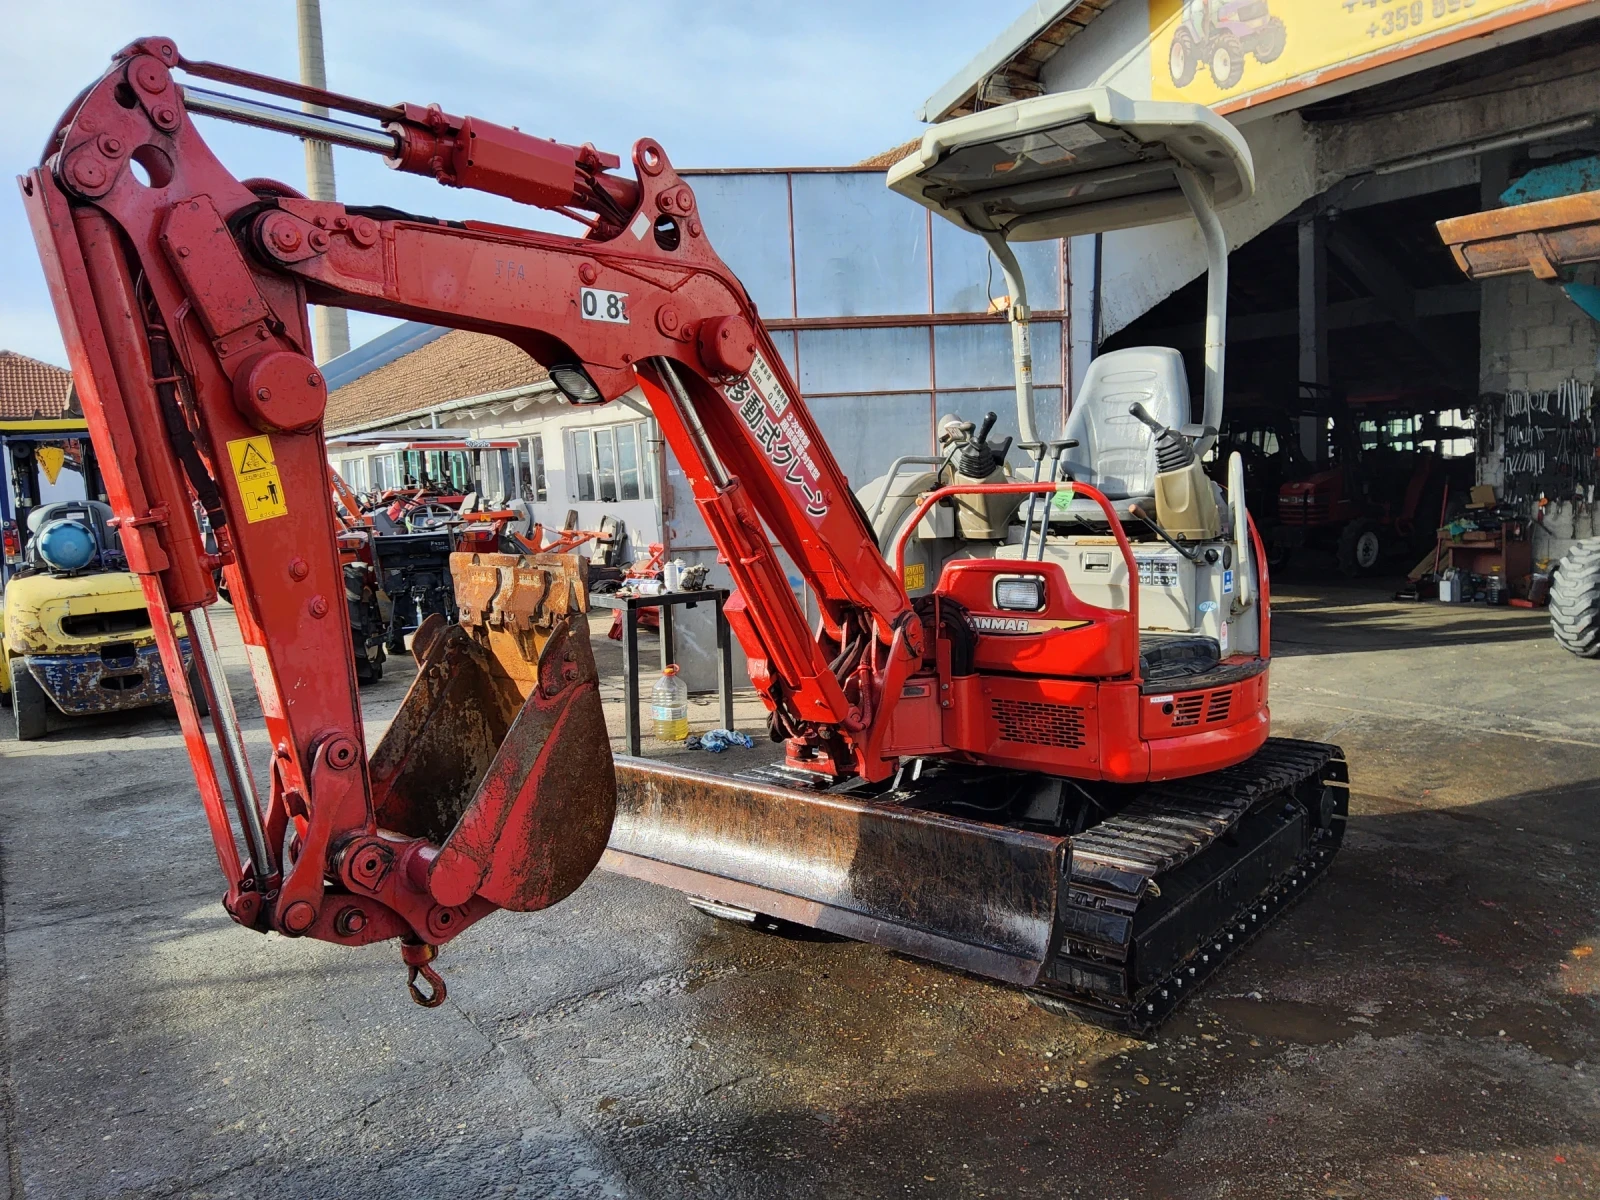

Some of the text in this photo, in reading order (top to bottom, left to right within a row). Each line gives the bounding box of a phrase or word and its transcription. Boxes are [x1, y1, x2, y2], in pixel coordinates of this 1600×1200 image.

[1366, 0, 1423, 38] +359
[724, 374, 827, 515] 移動式クレーン
[1200, 602, 1216, 612] OK
